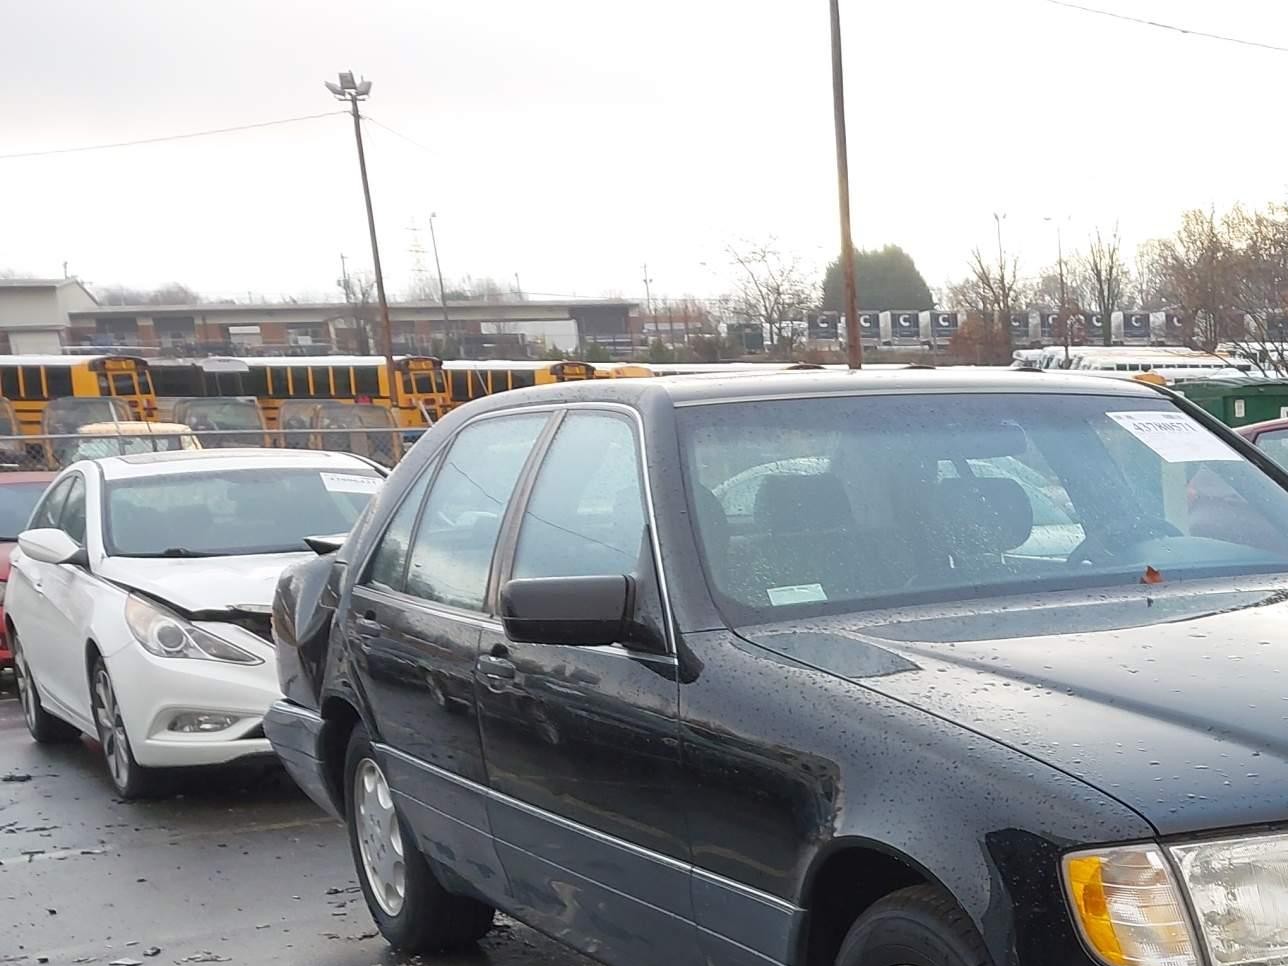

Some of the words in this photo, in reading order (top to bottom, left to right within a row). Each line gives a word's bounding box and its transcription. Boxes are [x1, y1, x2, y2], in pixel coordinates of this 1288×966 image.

[860, 315, 871, 327] C
[900, 314, 911, 326] C
[938, 314, 949, 326] C
[1132, 422, 1199, 432] 43780571
